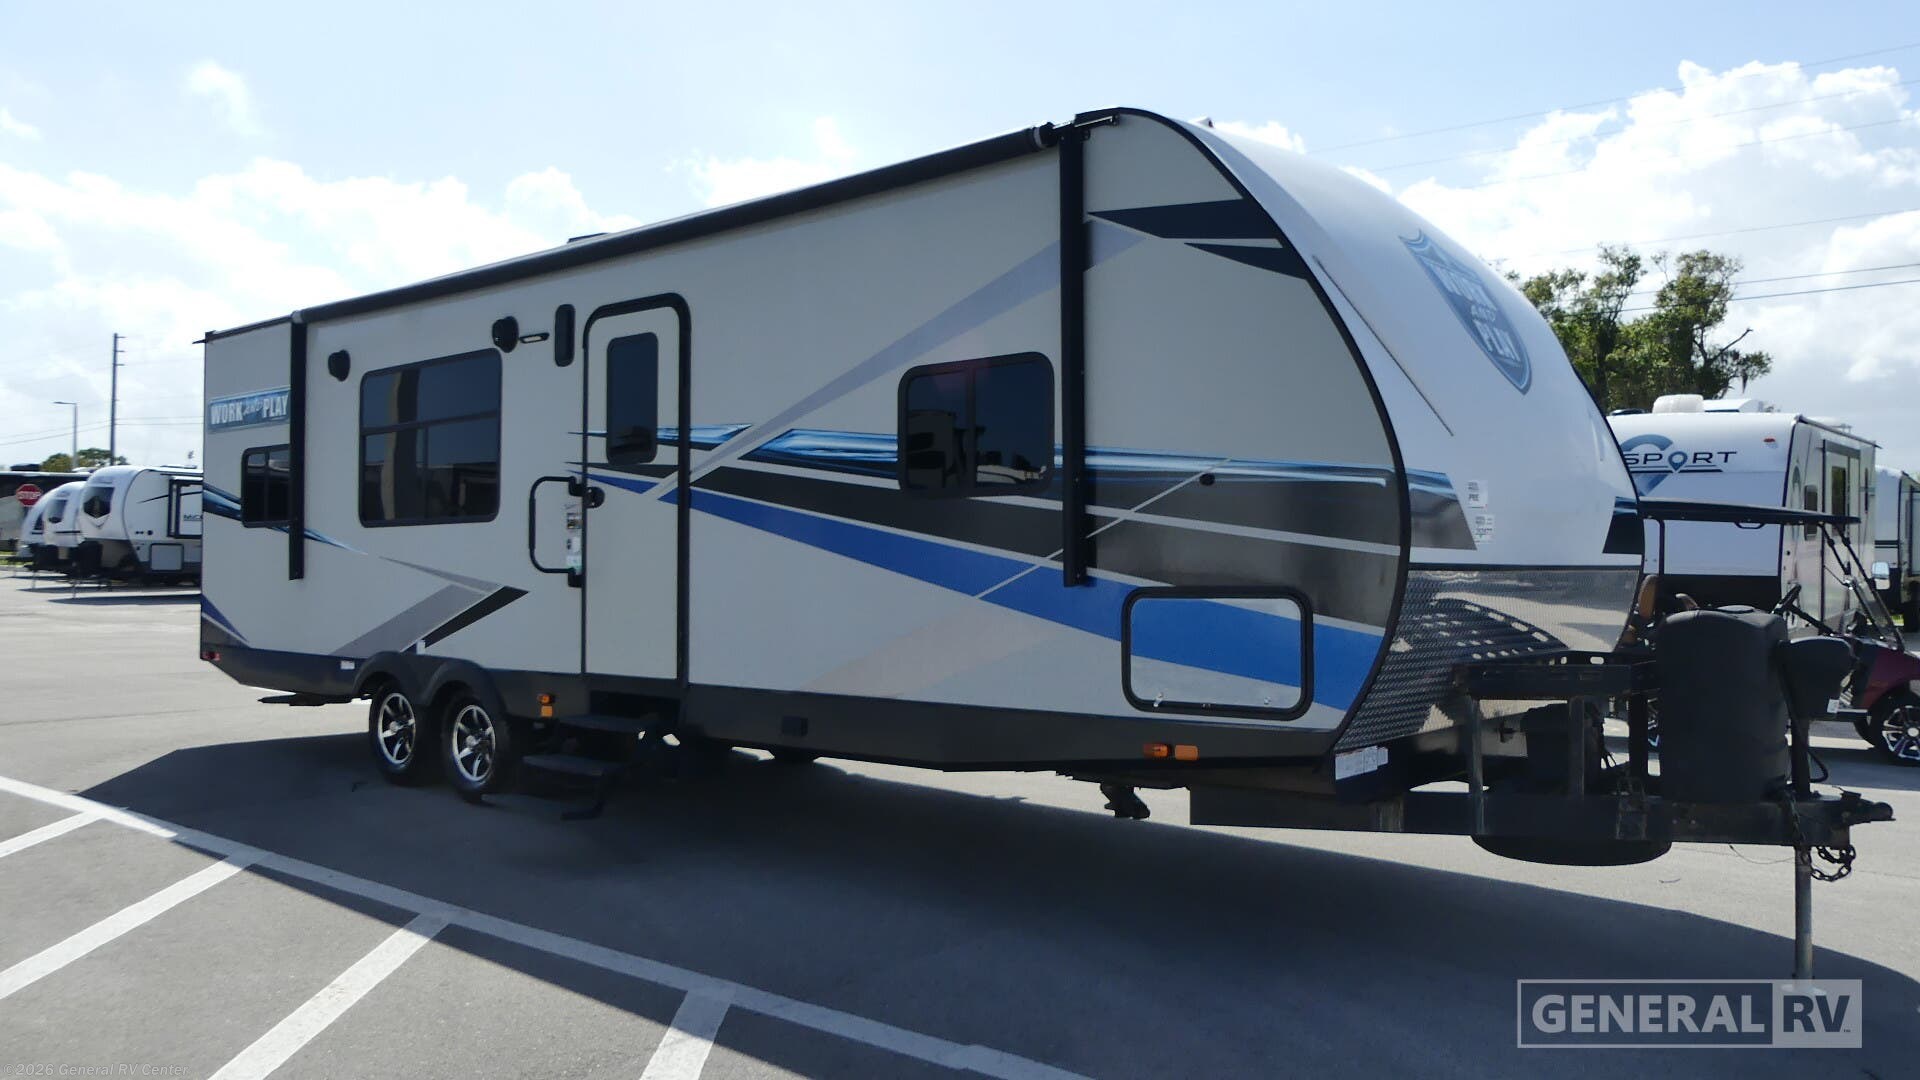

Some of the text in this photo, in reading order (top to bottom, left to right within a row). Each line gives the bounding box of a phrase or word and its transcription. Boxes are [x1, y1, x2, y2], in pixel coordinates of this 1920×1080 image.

[211, 402, 243, 425] WORK
[262, 395, 288, 418] PLAY
[17, 491, 41, 499] STOP
